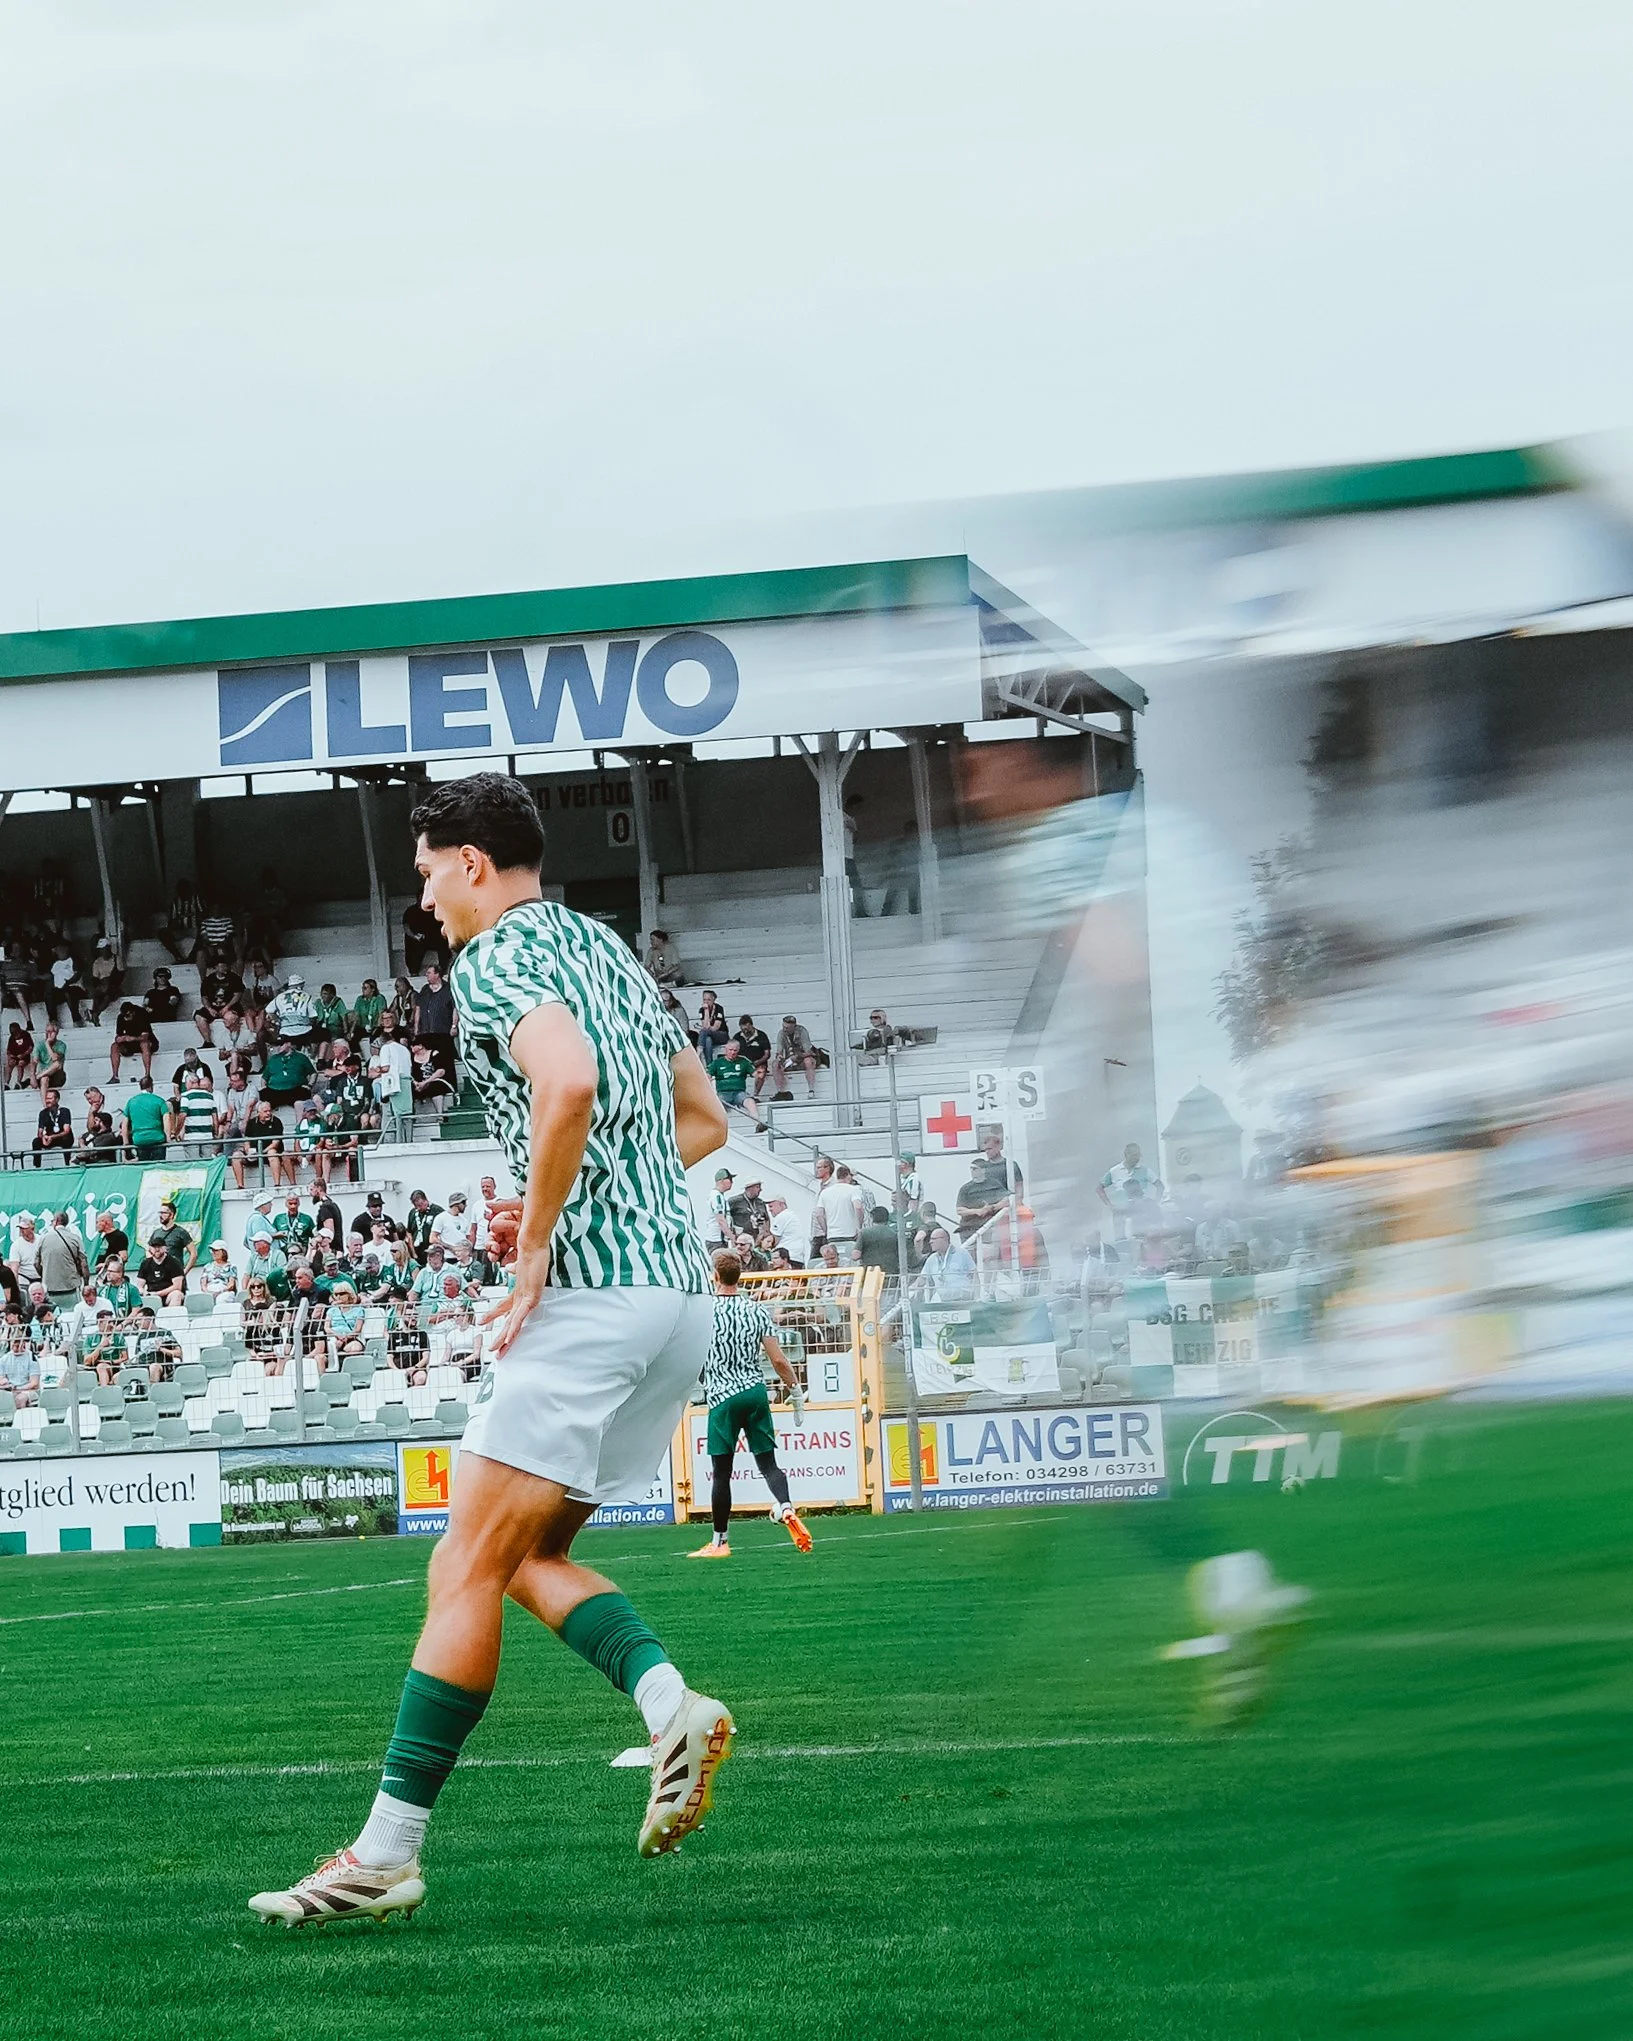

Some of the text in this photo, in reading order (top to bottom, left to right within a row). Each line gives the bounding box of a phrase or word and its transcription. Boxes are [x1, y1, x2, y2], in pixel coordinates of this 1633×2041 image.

[325, 630, 739, 757] LEWO
[557, 775, 669, 808] verbon
[1017, 1071, 1038, 1108] S
[946, 1412, 1154, 1467] LANGER
[950, 1470, 1019, 1485] Telefon:
[1025, 1465, 1089, 1481] 034298
[1105, 1462, 1157, 1476] 63731
[1204, 1431, 1342, 1485] TTM
[84, 1473, 195, 1505] werden!
[221, 1471, 393, 1504] Dein Baum für Sachsen
